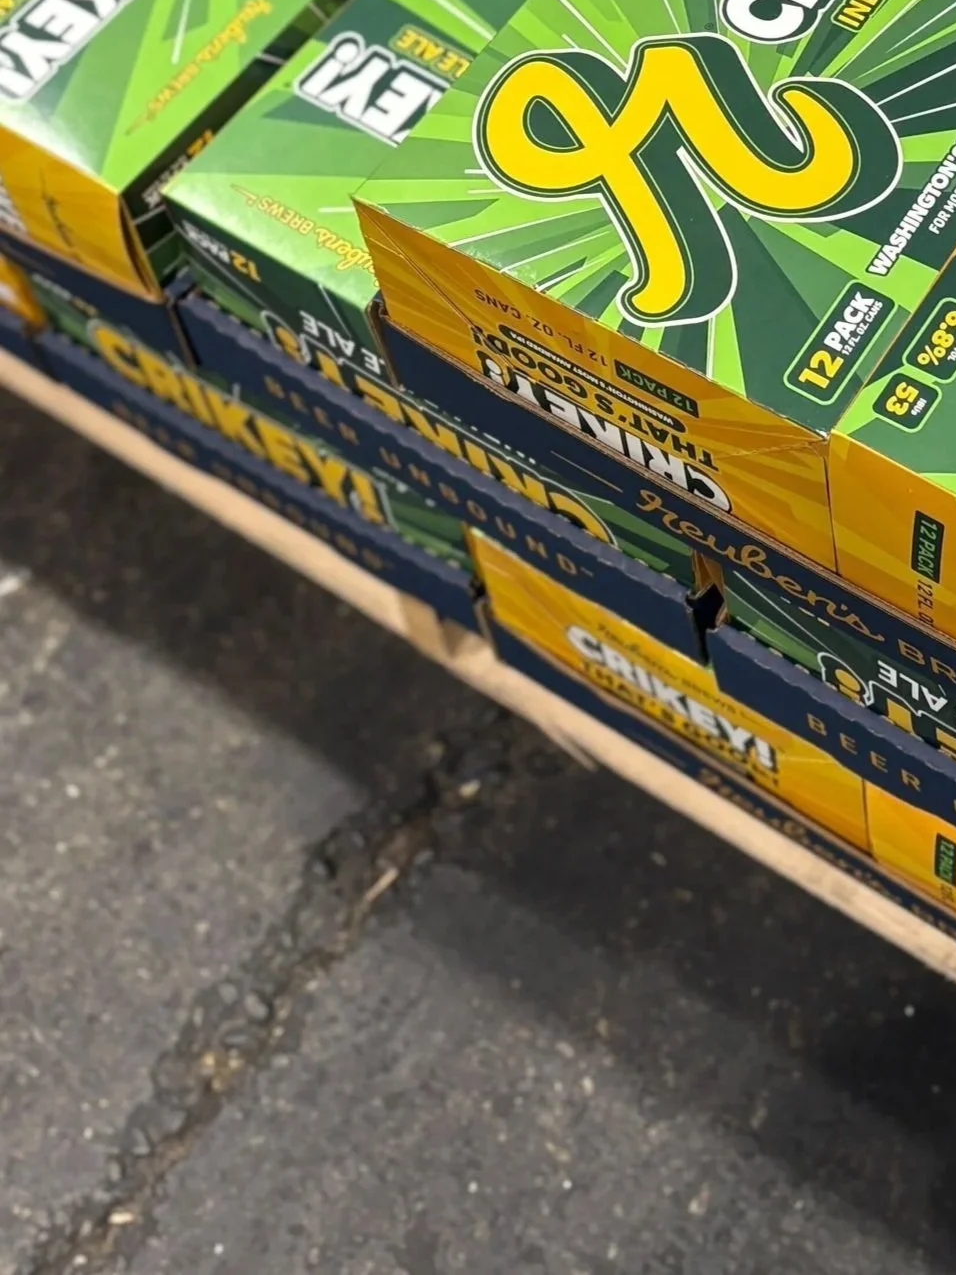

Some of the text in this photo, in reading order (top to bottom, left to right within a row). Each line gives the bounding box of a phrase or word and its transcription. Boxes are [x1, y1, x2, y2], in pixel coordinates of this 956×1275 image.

[397, 30, 470, 77] ALE LE
[260, 196, 316, 235] BREWS
[928, 211, 950, 234] FOR
[230, 250, 261, 282] 12
[474, 289, 521, 321] CANS
[842, 343, 853, 356] 12
[866, 300, 884, 326] CANS
[300, 310, 355, 357] ALE
[798, 291, 875, 389] 12 PACK
[507, 330, 675, 425] WASHINGTON'S MOST AWARDED IPA
[588, 348, 608, 367] 12
[471, 326, 720, 472] THAT'S GOOD!
[620, 365, 693, 412] 12 PACK
[885, 381, 919, 415] 53
[92, 323, 388, 524] CRIKEY!
[916, 519, 938, 580] 12 PACK
[917, 579, 933, 595] 12
[567, 625, 778, 773] CRIKEY!
[877, 659, 948, 712] ALE
[807, 712, 922, 792] BEER
